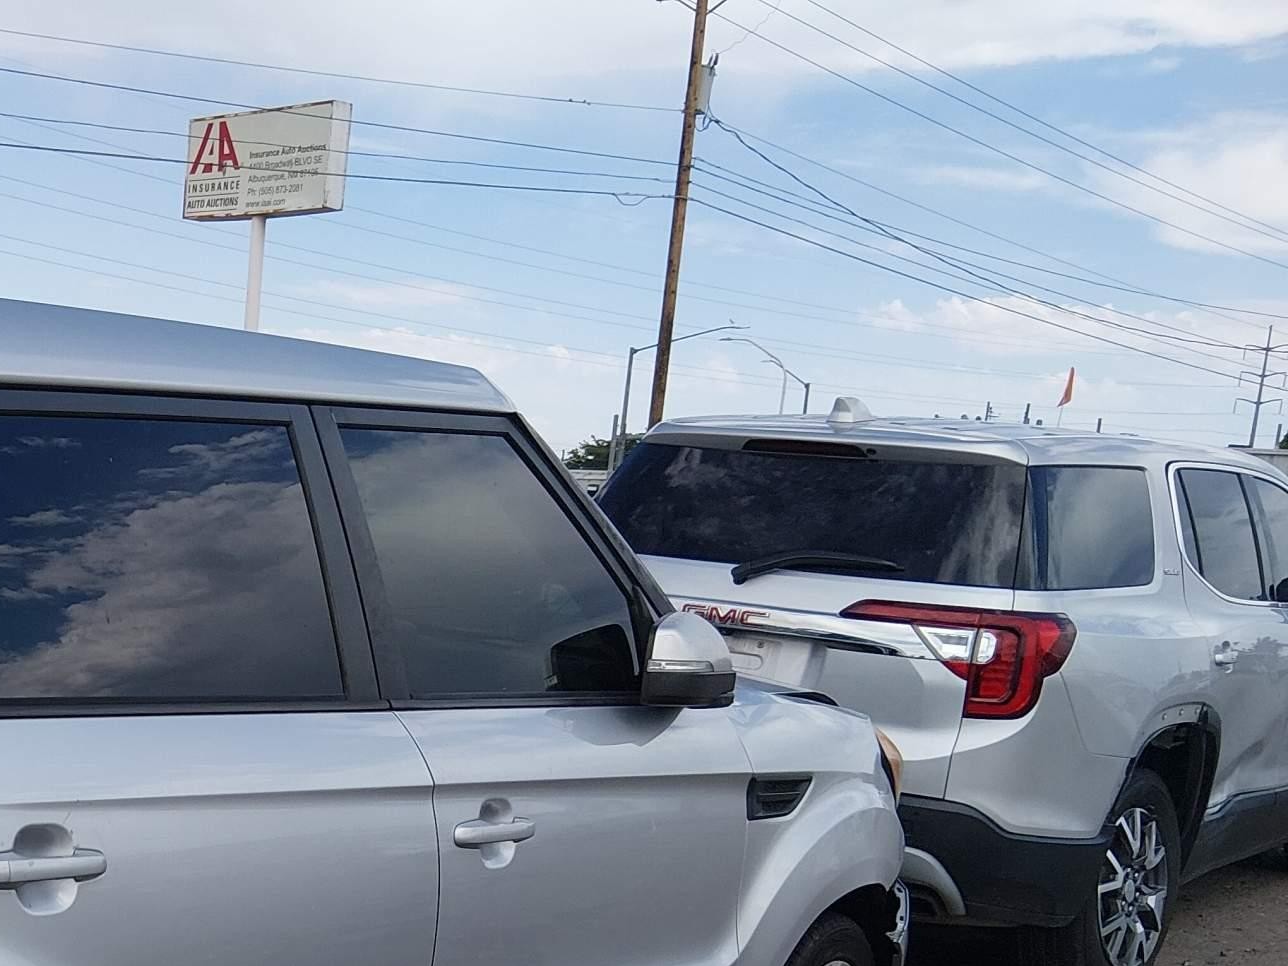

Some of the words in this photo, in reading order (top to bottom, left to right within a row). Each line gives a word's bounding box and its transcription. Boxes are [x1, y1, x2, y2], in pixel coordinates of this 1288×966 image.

[249, 150, 280, 159] Insurance
[281, 146, 296, 155] Auto
[297, 144, 327, 153] Auctions
[188, 180, 240, 193] INSURANCE
[187, 199, 205, 208] AUTO
[206, 196, 239, 208] AUCTIONS
[681, 603, 770, 628] GMC
